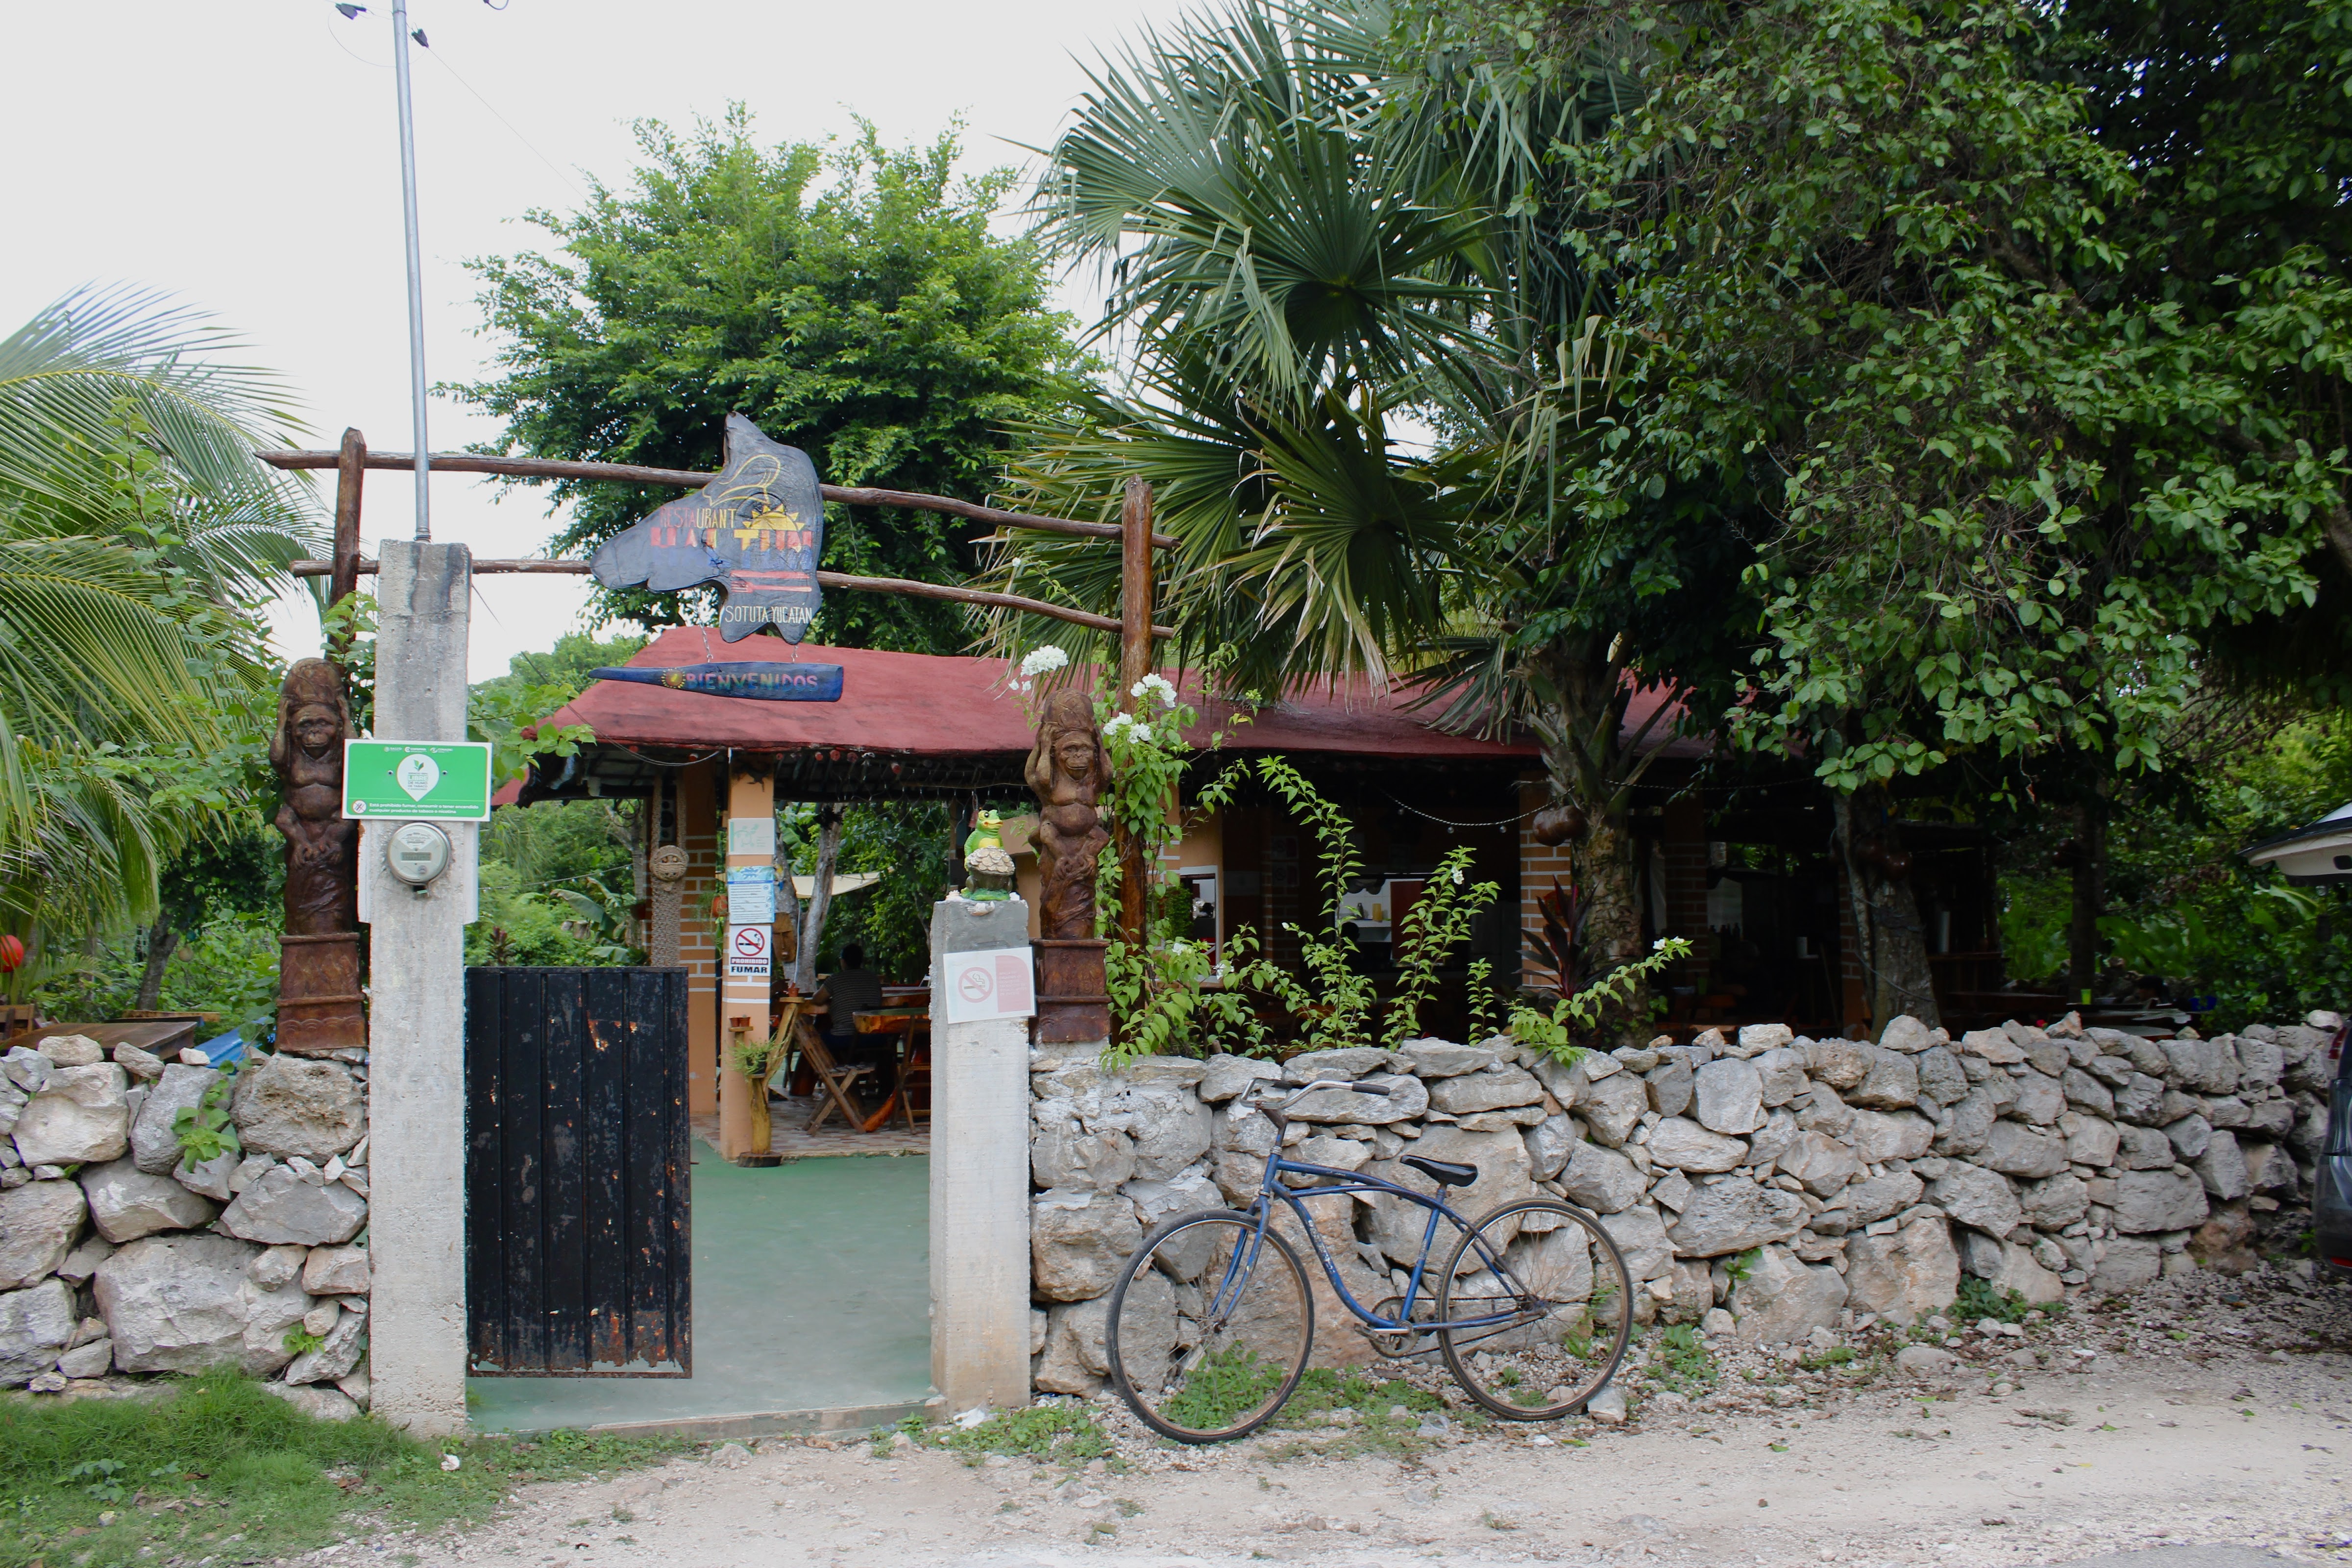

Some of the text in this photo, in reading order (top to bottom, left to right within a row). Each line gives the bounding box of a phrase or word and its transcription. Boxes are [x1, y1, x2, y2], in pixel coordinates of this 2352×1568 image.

[660, 506, 736, 529] RESTAURANT
[724, 603, 812, 624] SOTUTA YUCATÁN
[686, 672, 818, 691] BIENVENIDOS
